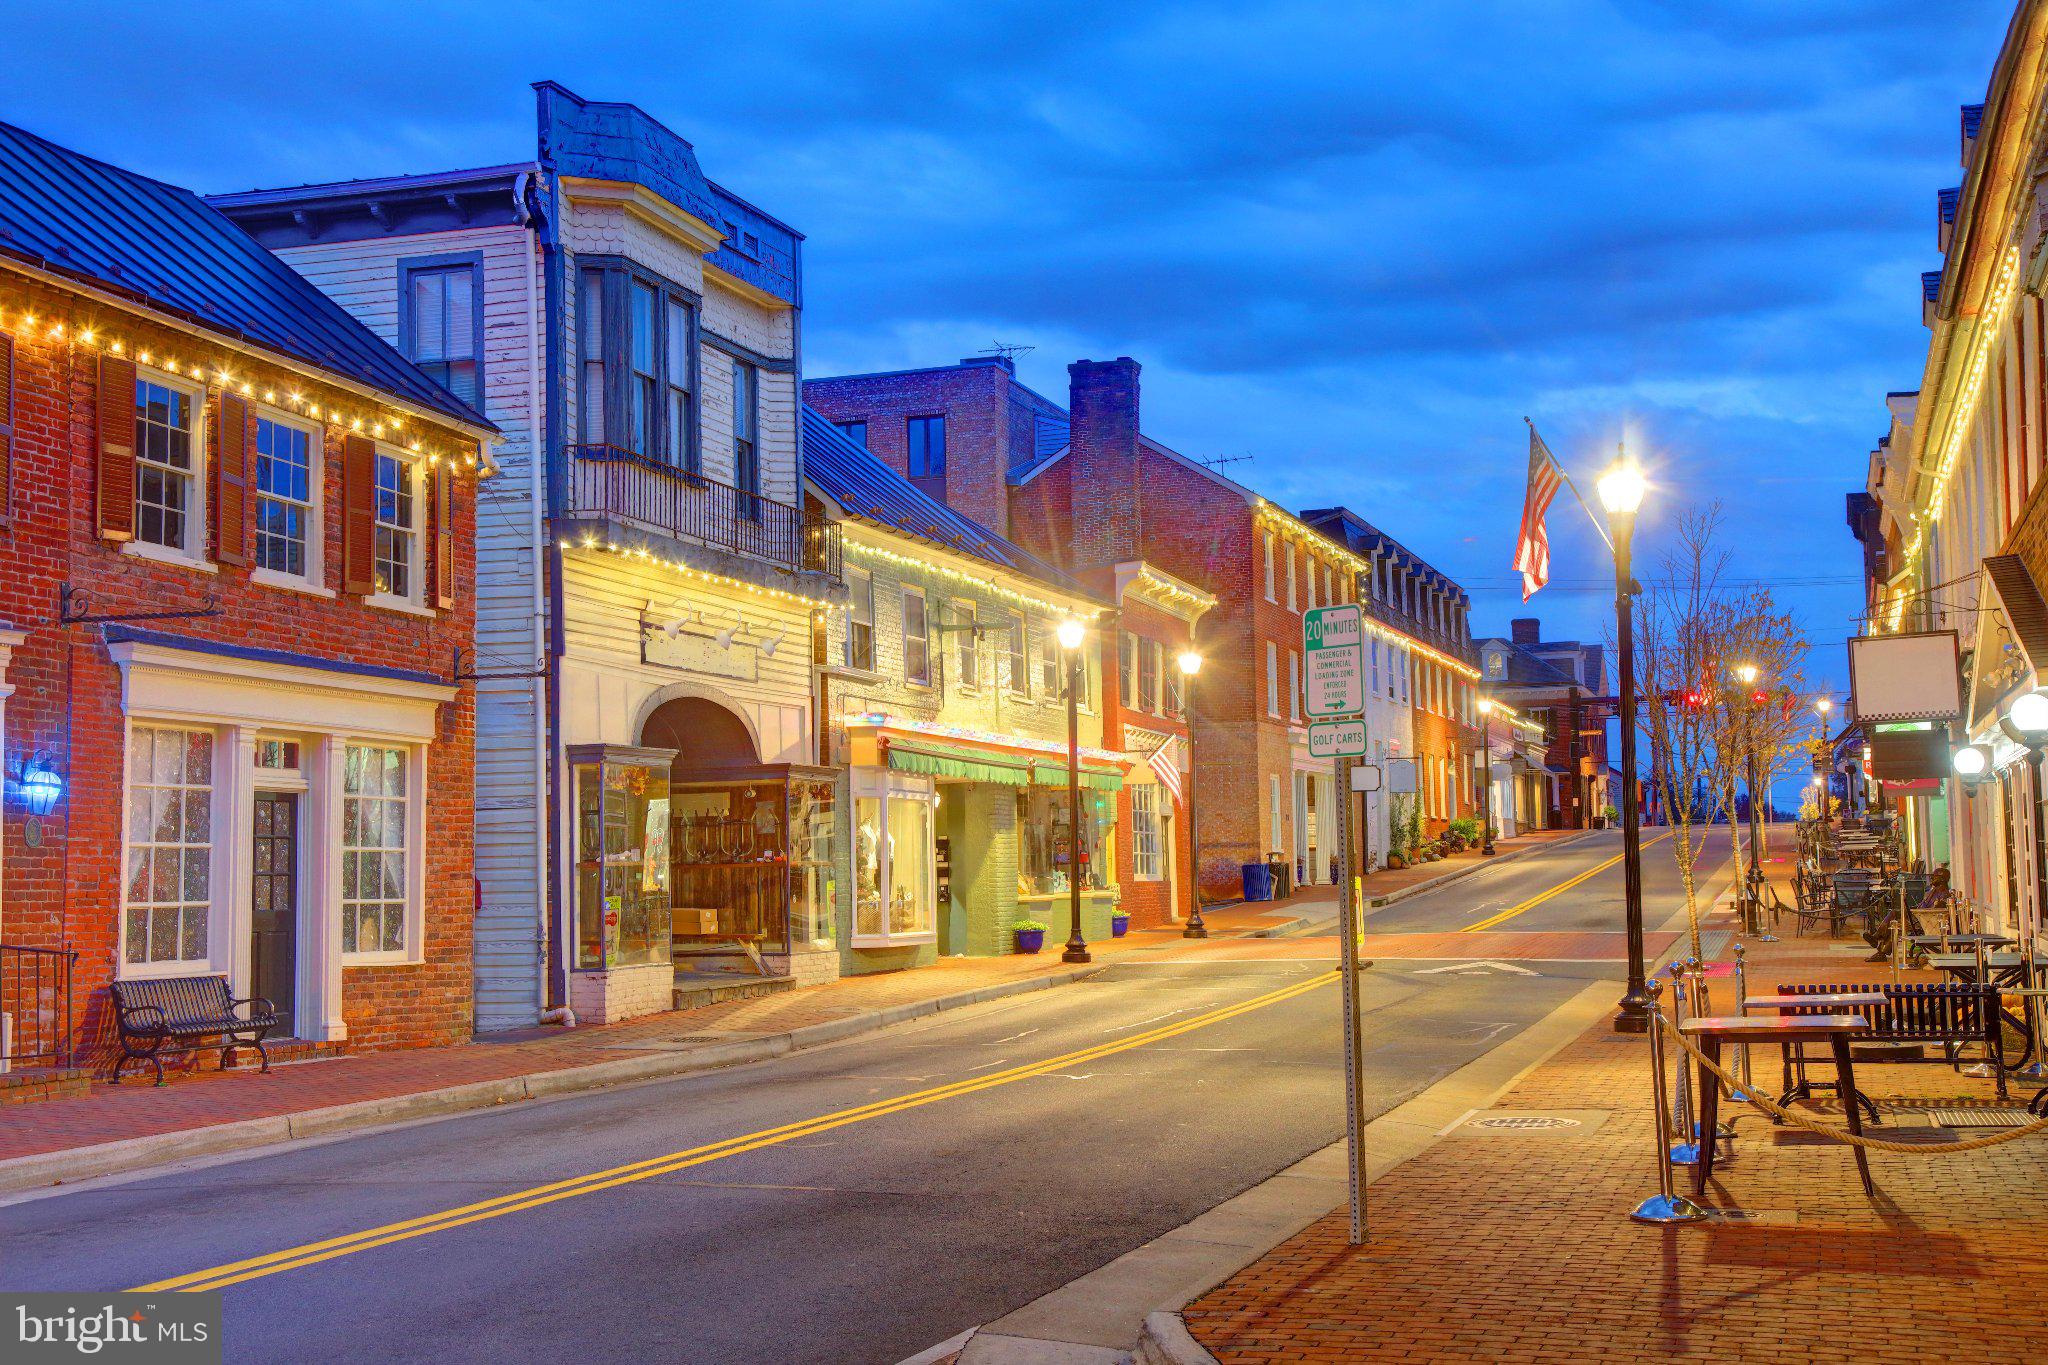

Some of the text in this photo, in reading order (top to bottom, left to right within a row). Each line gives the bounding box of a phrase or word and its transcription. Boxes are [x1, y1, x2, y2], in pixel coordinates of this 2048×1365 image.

[1306, 618, 1358, 641] 20 MINUTES
[1315, 649, 1352, 660] PASSENGER &
[1316, 660, 1352, 670] COMMERCIAL
[1314, 669, 1354, 680] LOADING ZONE
[1323, 680, 1347, 690] ENFORCED
[1324, 690, 1347, 700] 24 HOURS
[1313, 732, 1363, 746] GOLF CARTS
